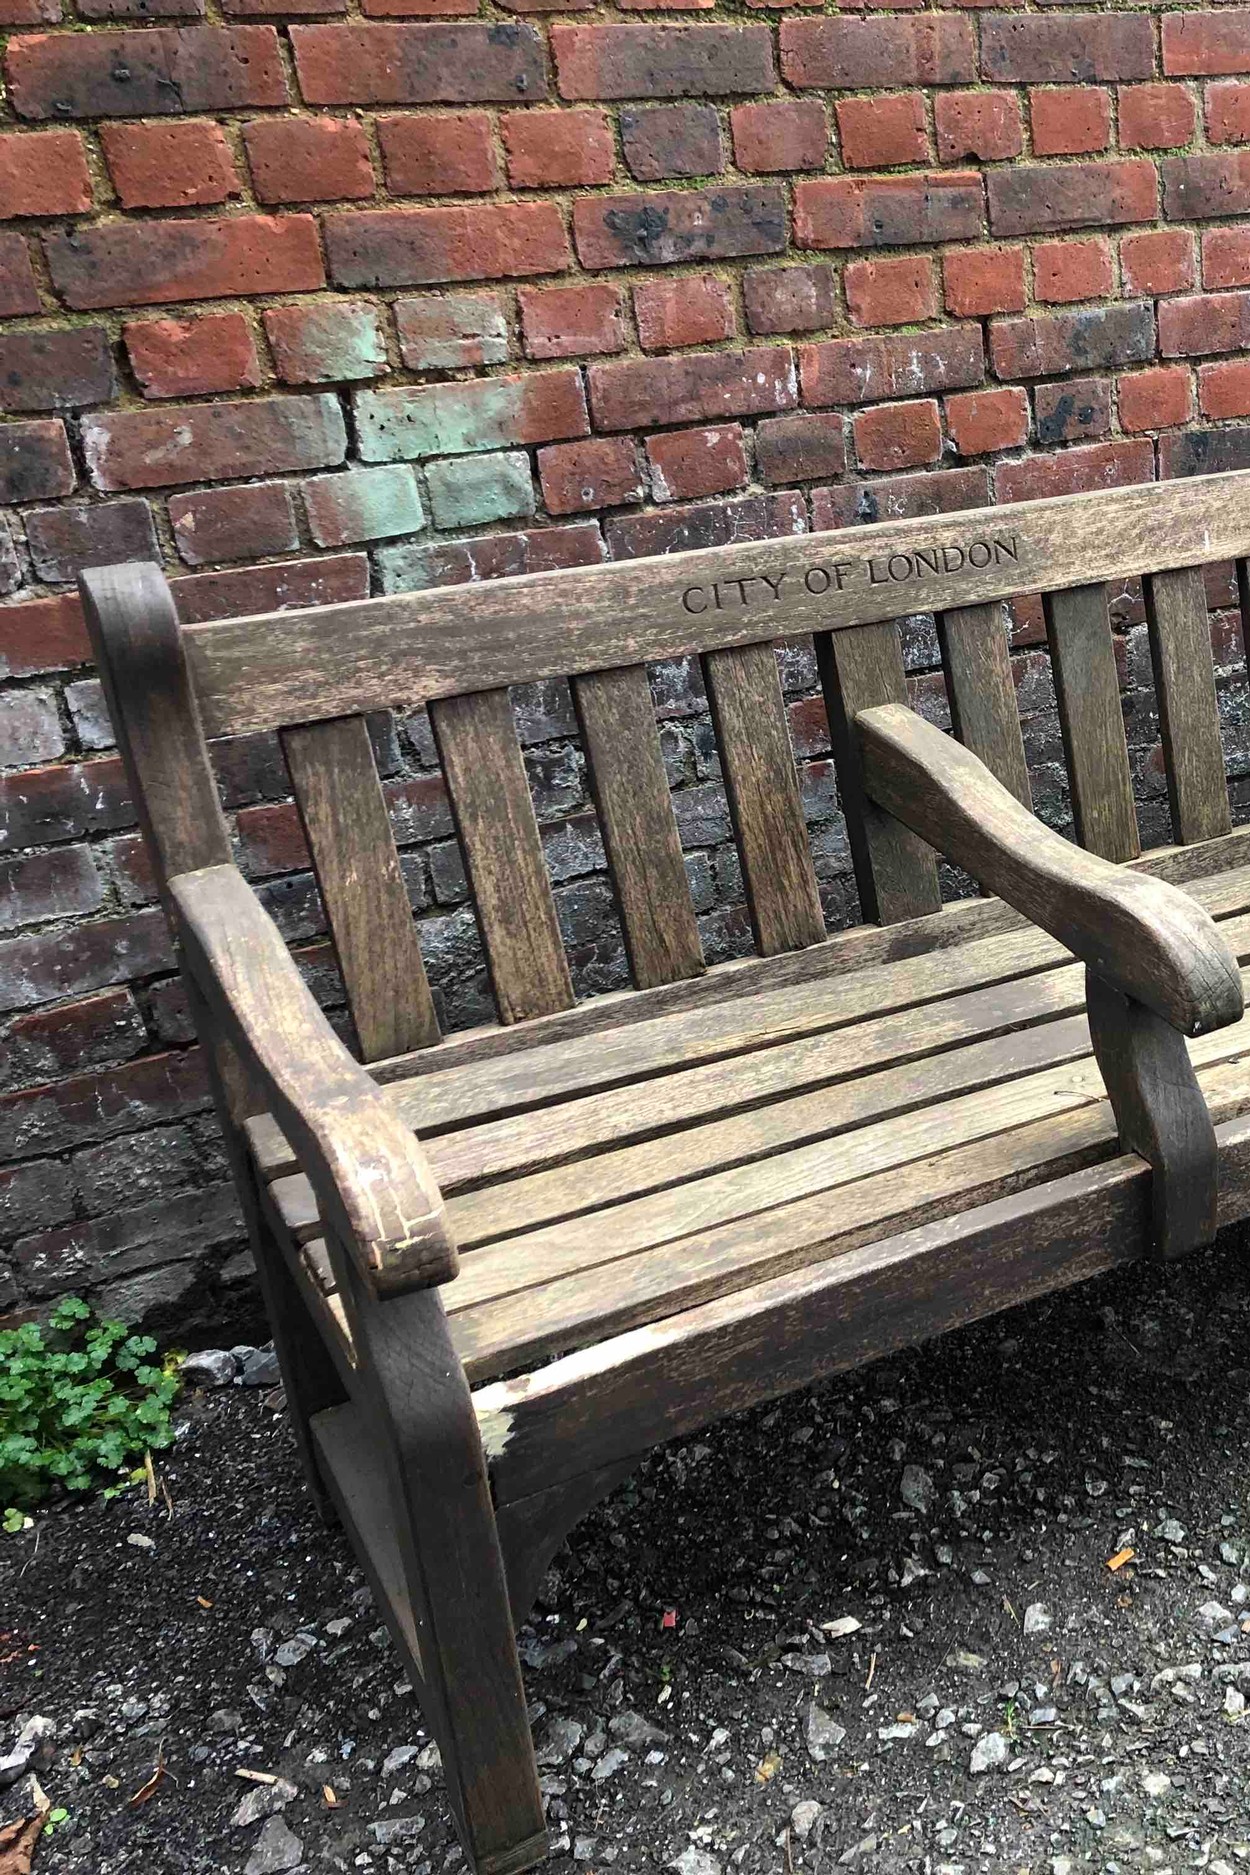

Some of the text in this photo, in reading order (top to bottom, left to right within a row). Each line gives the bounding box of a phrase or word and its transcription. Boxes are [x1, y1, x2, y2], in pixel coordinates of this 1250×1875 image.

[682, 536, 1020, 614] CITY OF LONDON
